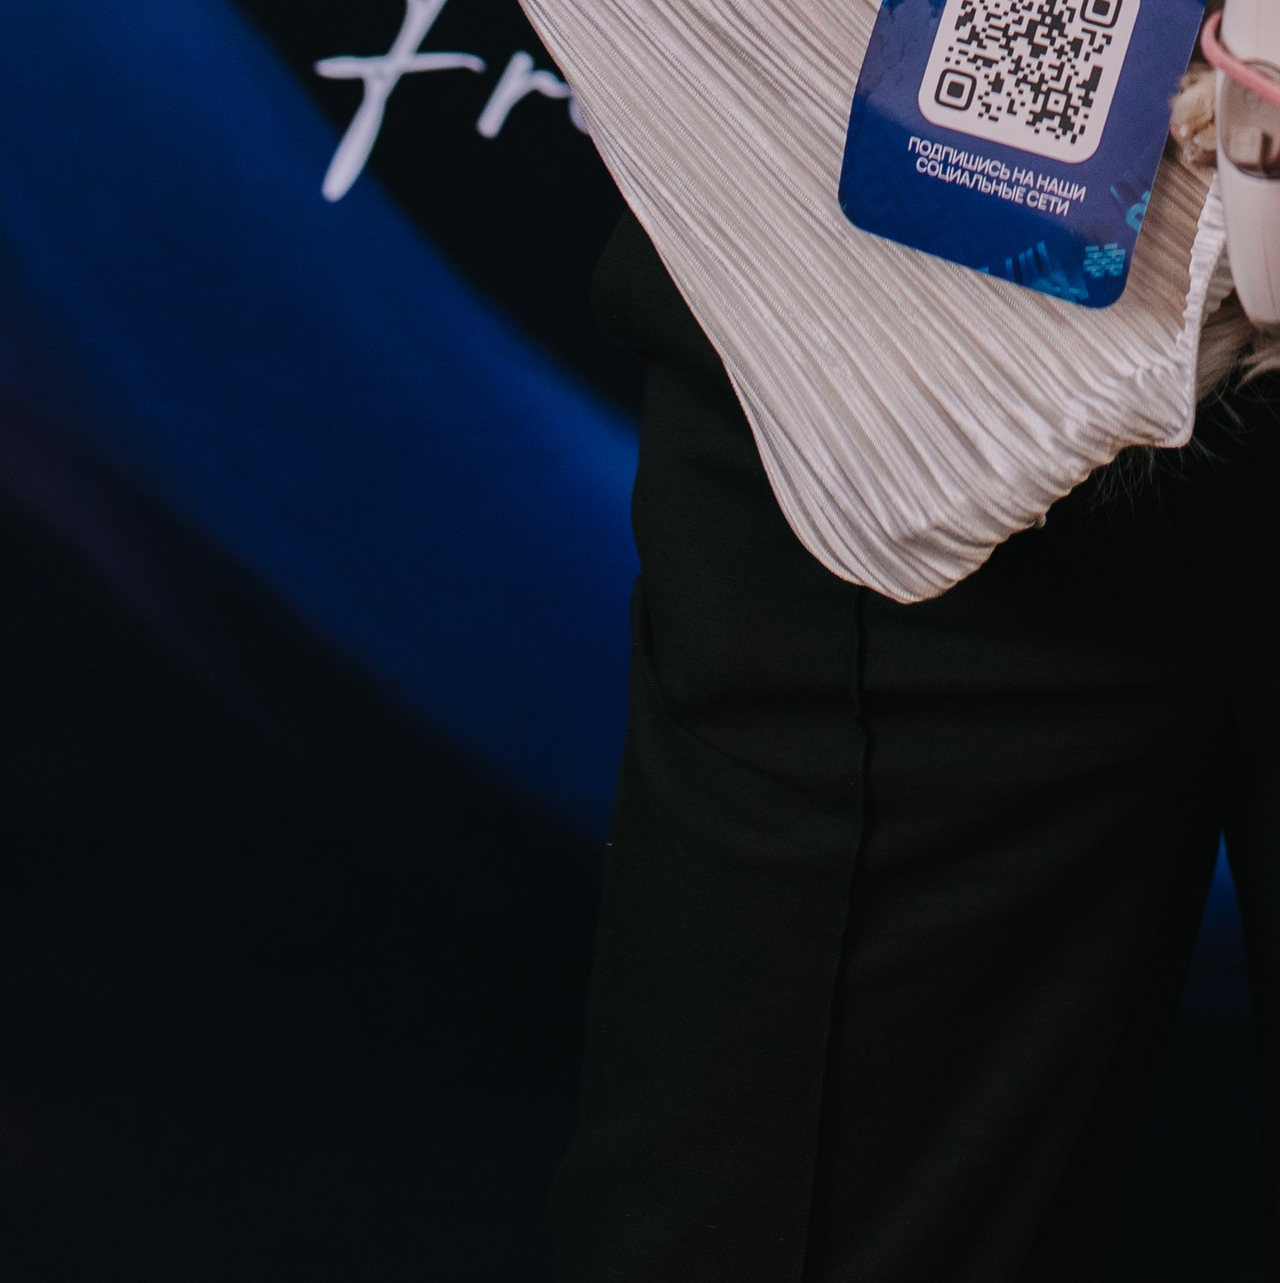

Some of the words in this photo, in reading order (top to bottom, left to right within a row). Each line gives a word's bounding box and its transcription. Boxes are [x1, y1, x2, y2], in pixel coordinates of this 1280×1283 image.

[907, 135, 1011, 180] ПОДПИШИСЬ
[1011, 166, 1034, 188] НА
[1035, 172, 1087, 203] НАШИ
[915, 156, 1026, 205] СОЦИАЛЬНЫЕ
[1026, 189, 1071, 217] СЕТИ
